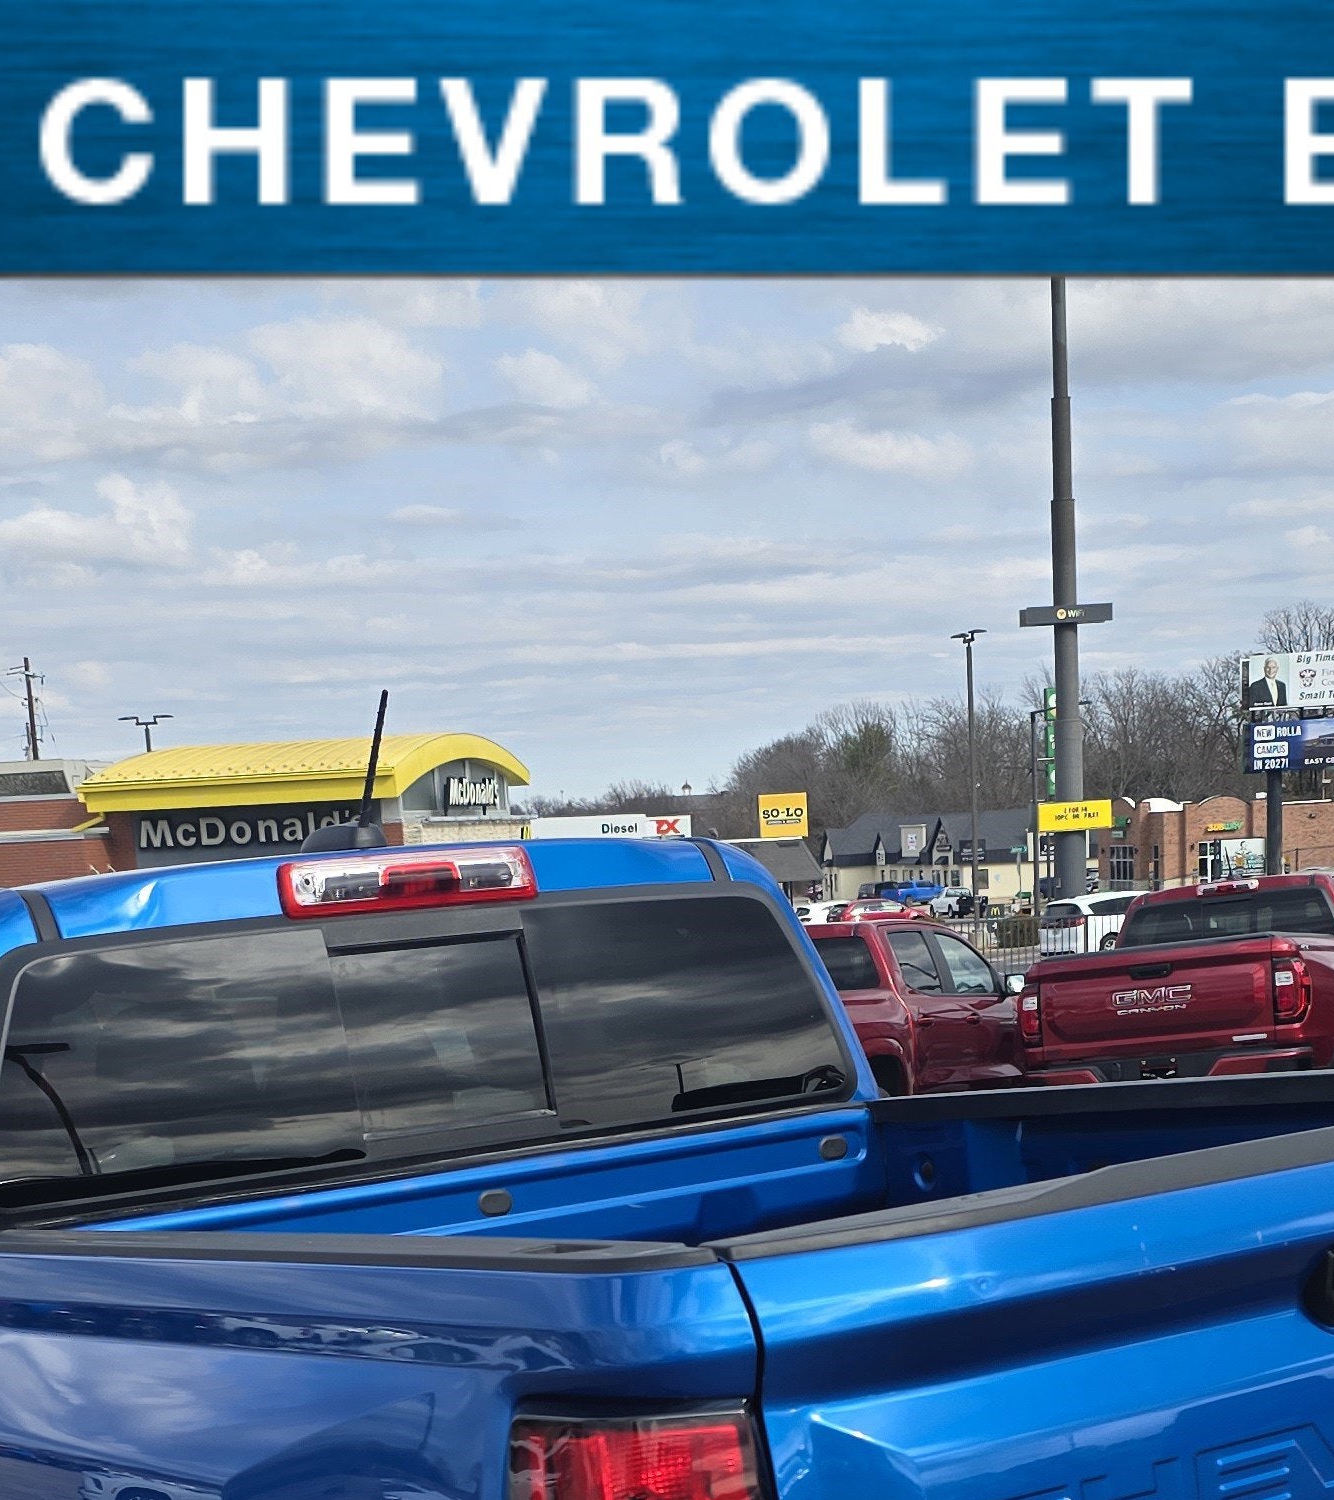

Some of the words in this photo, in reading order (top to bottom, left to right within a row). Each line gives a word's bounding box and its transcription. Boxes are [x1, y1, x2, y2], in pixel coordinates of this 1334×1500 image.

[1296, 654, 1312, 664] Big
[1298, 691, 1326, 700] Small
[1256, 728, 1273, 738] NEW
[1276, 725, 1302, 738] ROLLA
[1256, 743, 1287, 756] CAMPUS
[1304, 757, 1324, 766] EAST
[449, 776, 500, 808] McDonald's
[762, 807, 804, 820] SO-LO
[601, 821, 638, 835] Diesel
[1112, 984, 1192, 1008] GMC
[1117, 1002, 1187, 1016] CANYON
